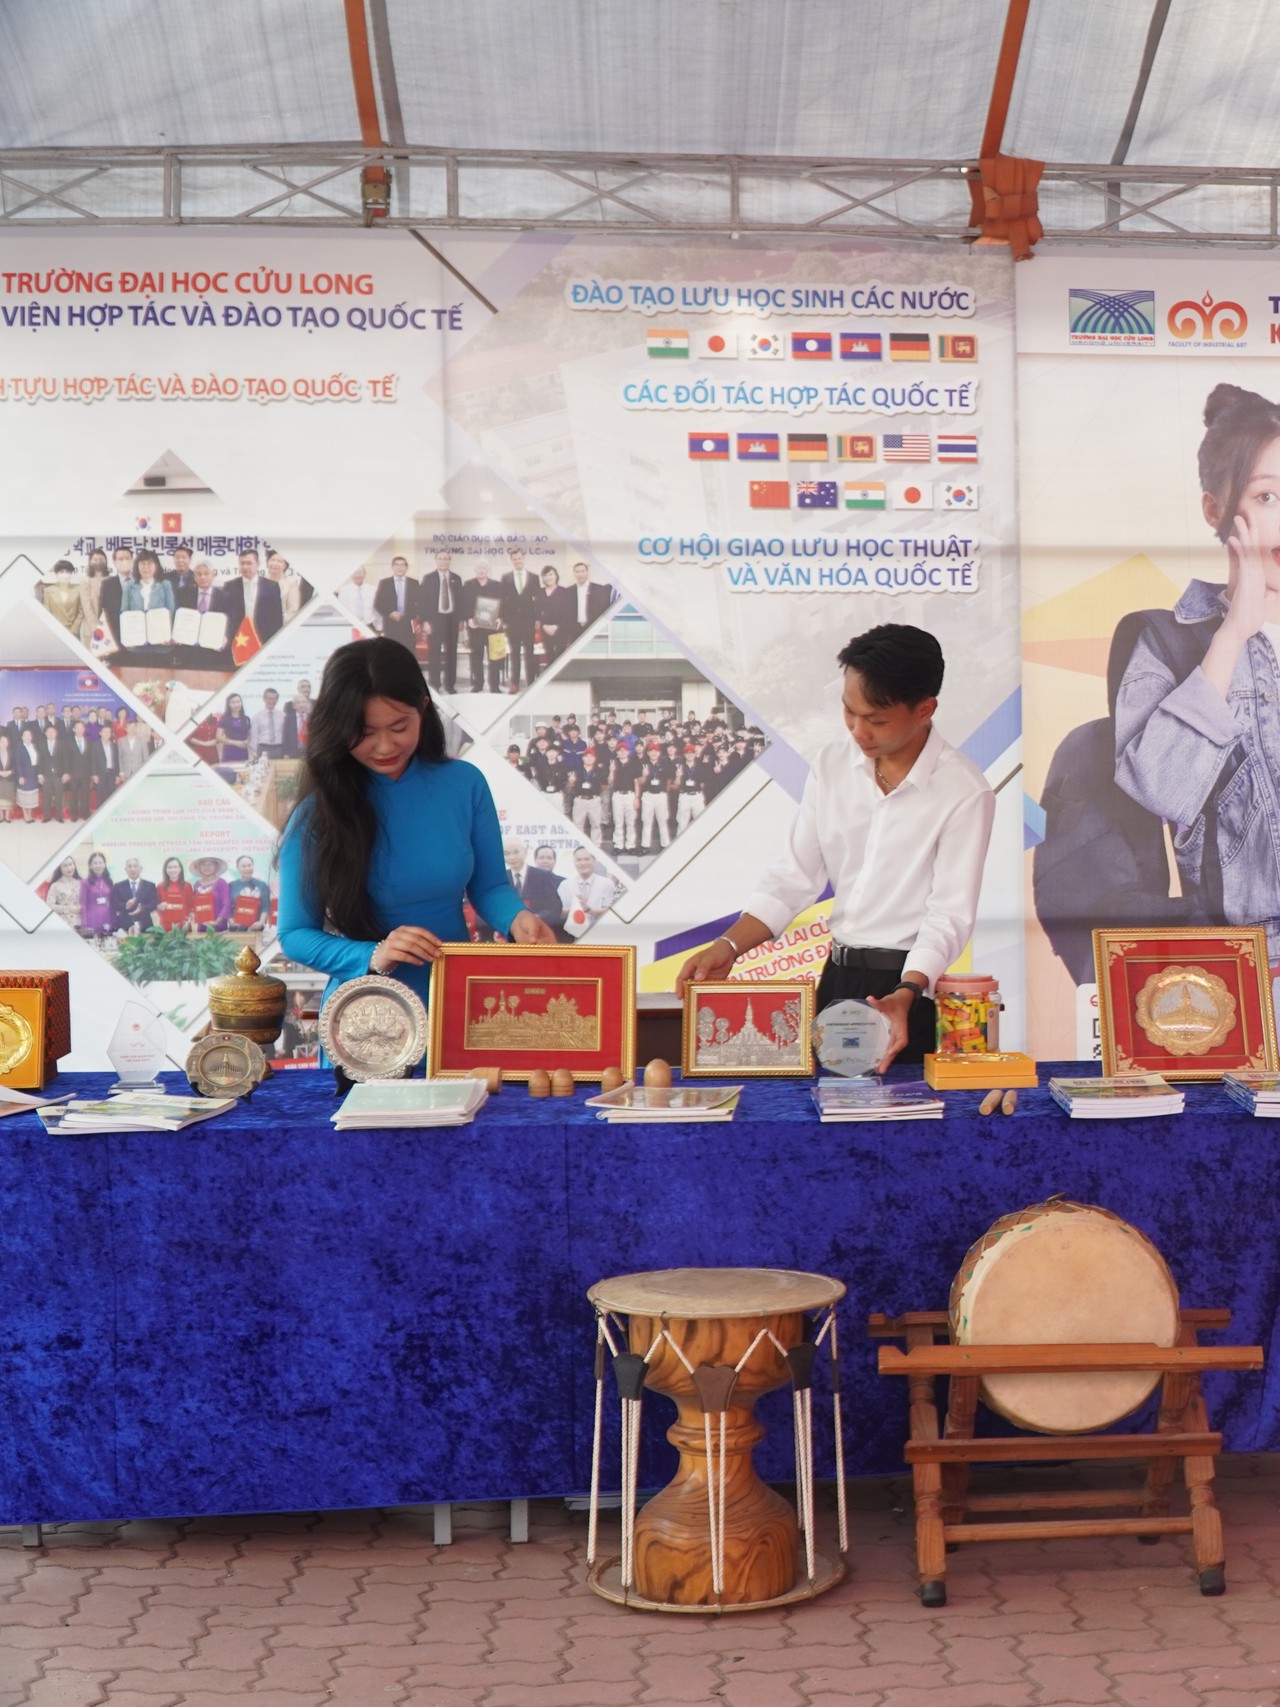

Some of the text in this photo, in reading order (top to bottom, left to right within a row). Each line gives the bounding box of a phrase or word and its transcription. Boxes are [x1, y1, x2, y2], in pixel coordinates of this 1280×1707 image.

[2, 266, 374, 299] TRƯỜNG ĐẠI HỌC CỬU LONG
[570, 281, 970, 312] ĐÀO TẠO LƯU HỌC SINH CÁC NƯỚC
[1, 301, 464, 334] VIỆN HỢP TÁC VÀ ĐÀO TẠO QUỐC TẾ
[11, 377, 57, 400] TỰU
[63, 376, 109, 400] HỢP
[114, 372, 153, 396] TÁC
[157, 372, 187, 396] VÀ
[190, 373, 239, 396] ĐÀO
[243, 378, 286, 401] TẠO
[291, 373, 359, 399] QUỐC
[367, 373, 396, 399] TẾ
[623, 378, 974, 410] CÁC ĐỐI TÁC HỢP TÁC QUỐC TẾ
[638, 533, 973, 561] CƠ HỘI GIAO LƯU HỌC THUẬT
[727, 560, 975, 589] VÀ VĂN HÓA QUỐC TẾ
[516, 825, 546, 835] EAST
[784, 927, 809, 947] LAI
[744, 949, 814, 981] TRƯỜNG
